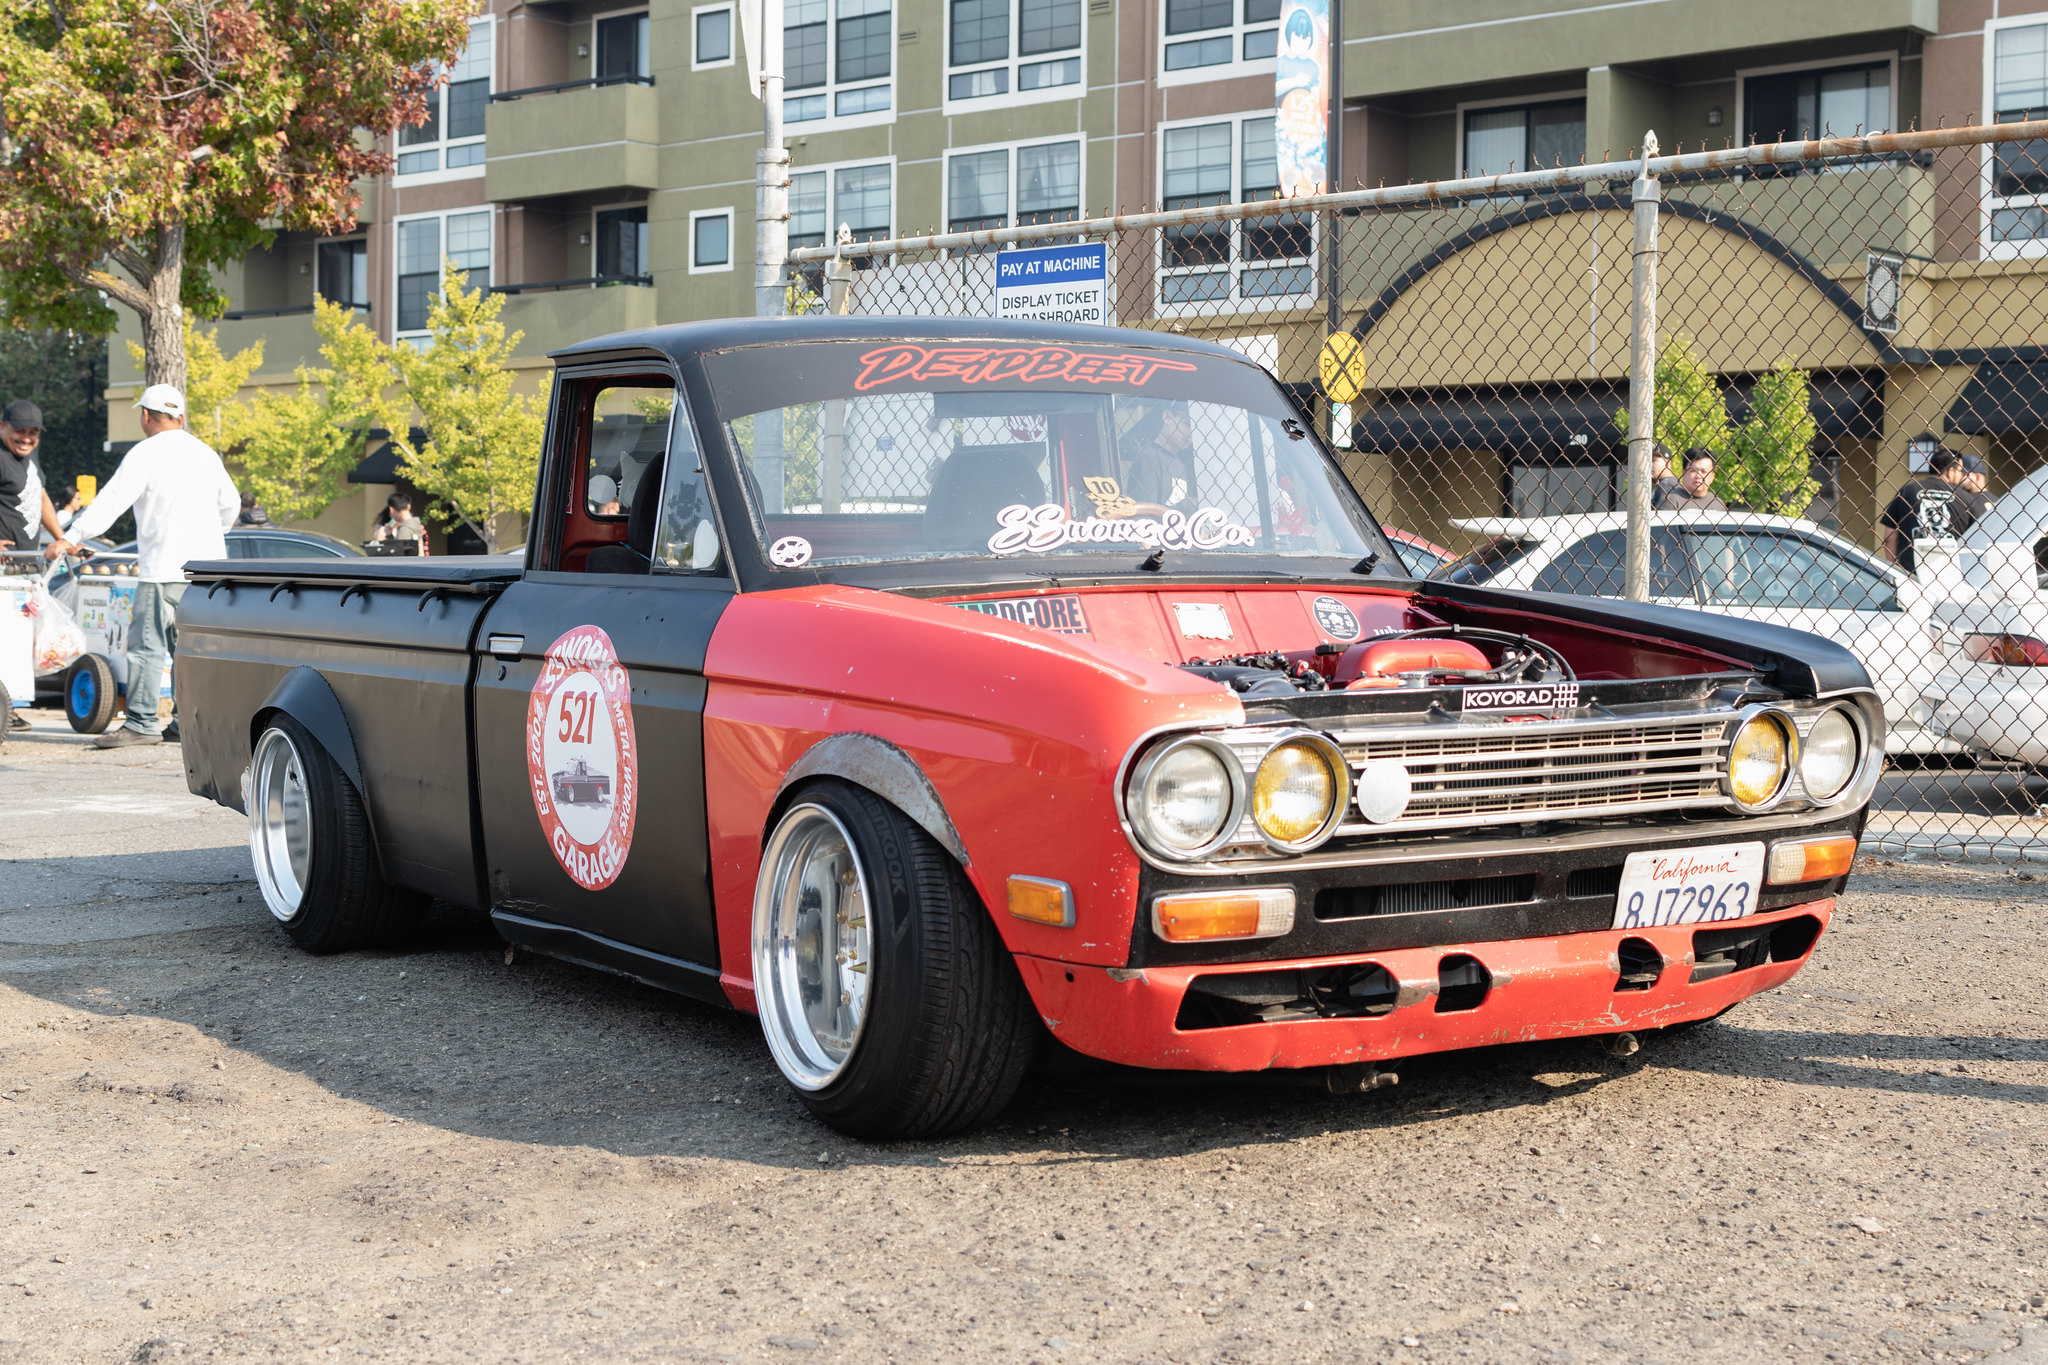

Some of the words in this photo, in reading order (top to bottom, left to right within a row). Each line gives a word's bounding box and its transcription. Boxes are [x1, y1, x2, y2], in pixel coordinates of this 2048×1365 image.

[1001, 263, 1024, 277] PAY
[1025, 261, 1042, 275] AT
[1044, 255, 1101, 273] MACHINE
[1002, 294, 1052, 309] DISPLAY
[1055, 290, 1099, 305] TICKET
[854, 345, 1198, 391] DEADBEET
[1324, 357, 1333, 375] R
[1353, 360, 1361, 378] R
[1091, 480, 1116, 495] 10
[1466, 689, 1552, 707] KOYORAD
[559, 690, 598, 745] 521
[612, 700, 632, 760] METAL
[534, 772, 550, 816] EST.
[619, 766, 633, 837] WORKS
[553, 826, 621, 885] GARAGE
[1652, 856, 1737, 885] California
